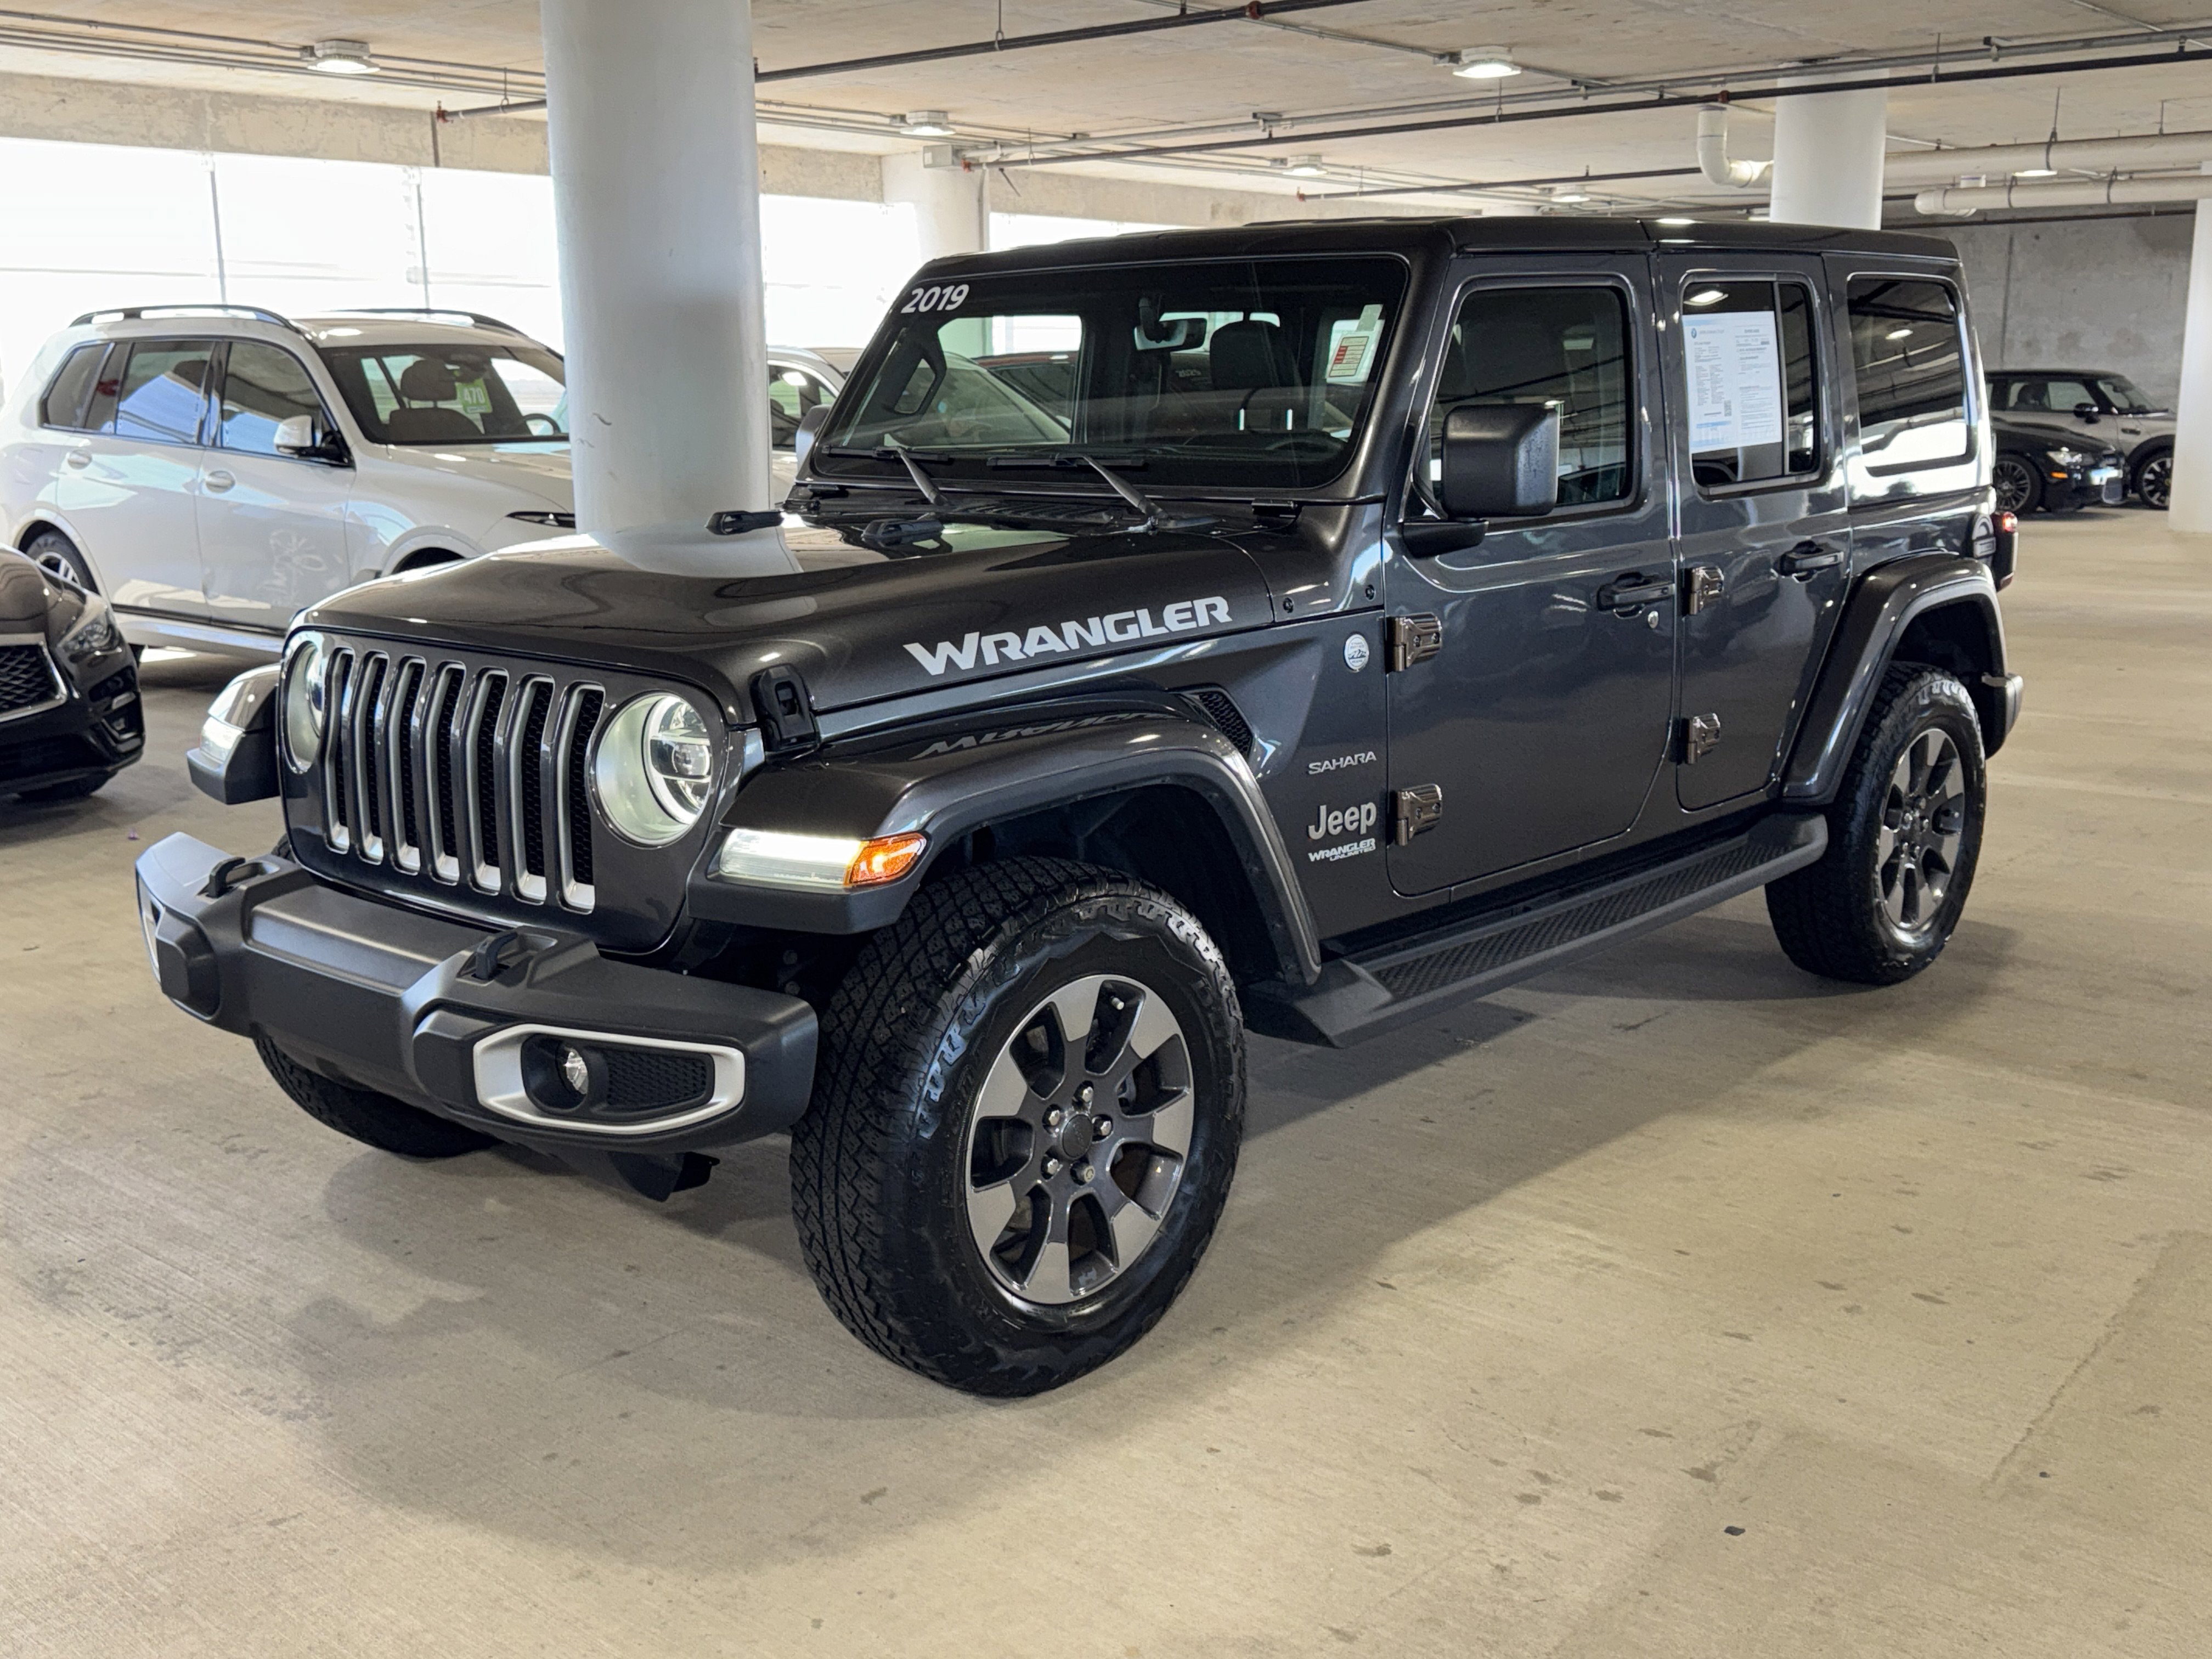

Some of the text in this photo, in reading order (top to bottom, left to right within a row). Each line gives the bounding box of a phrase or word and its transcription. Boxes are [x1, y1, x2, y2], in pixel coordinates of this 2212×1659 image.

[900, 284, 969, 314] 2019
[463, 387, 486, 404] 470
[903, 596, 1233, 675] WRANGLER
[1308, 751, 1376, 775] SAHARA
[1308, 802, 1376, 840] Jeep
[1308, 838, 1376, 862] WRANGLER
